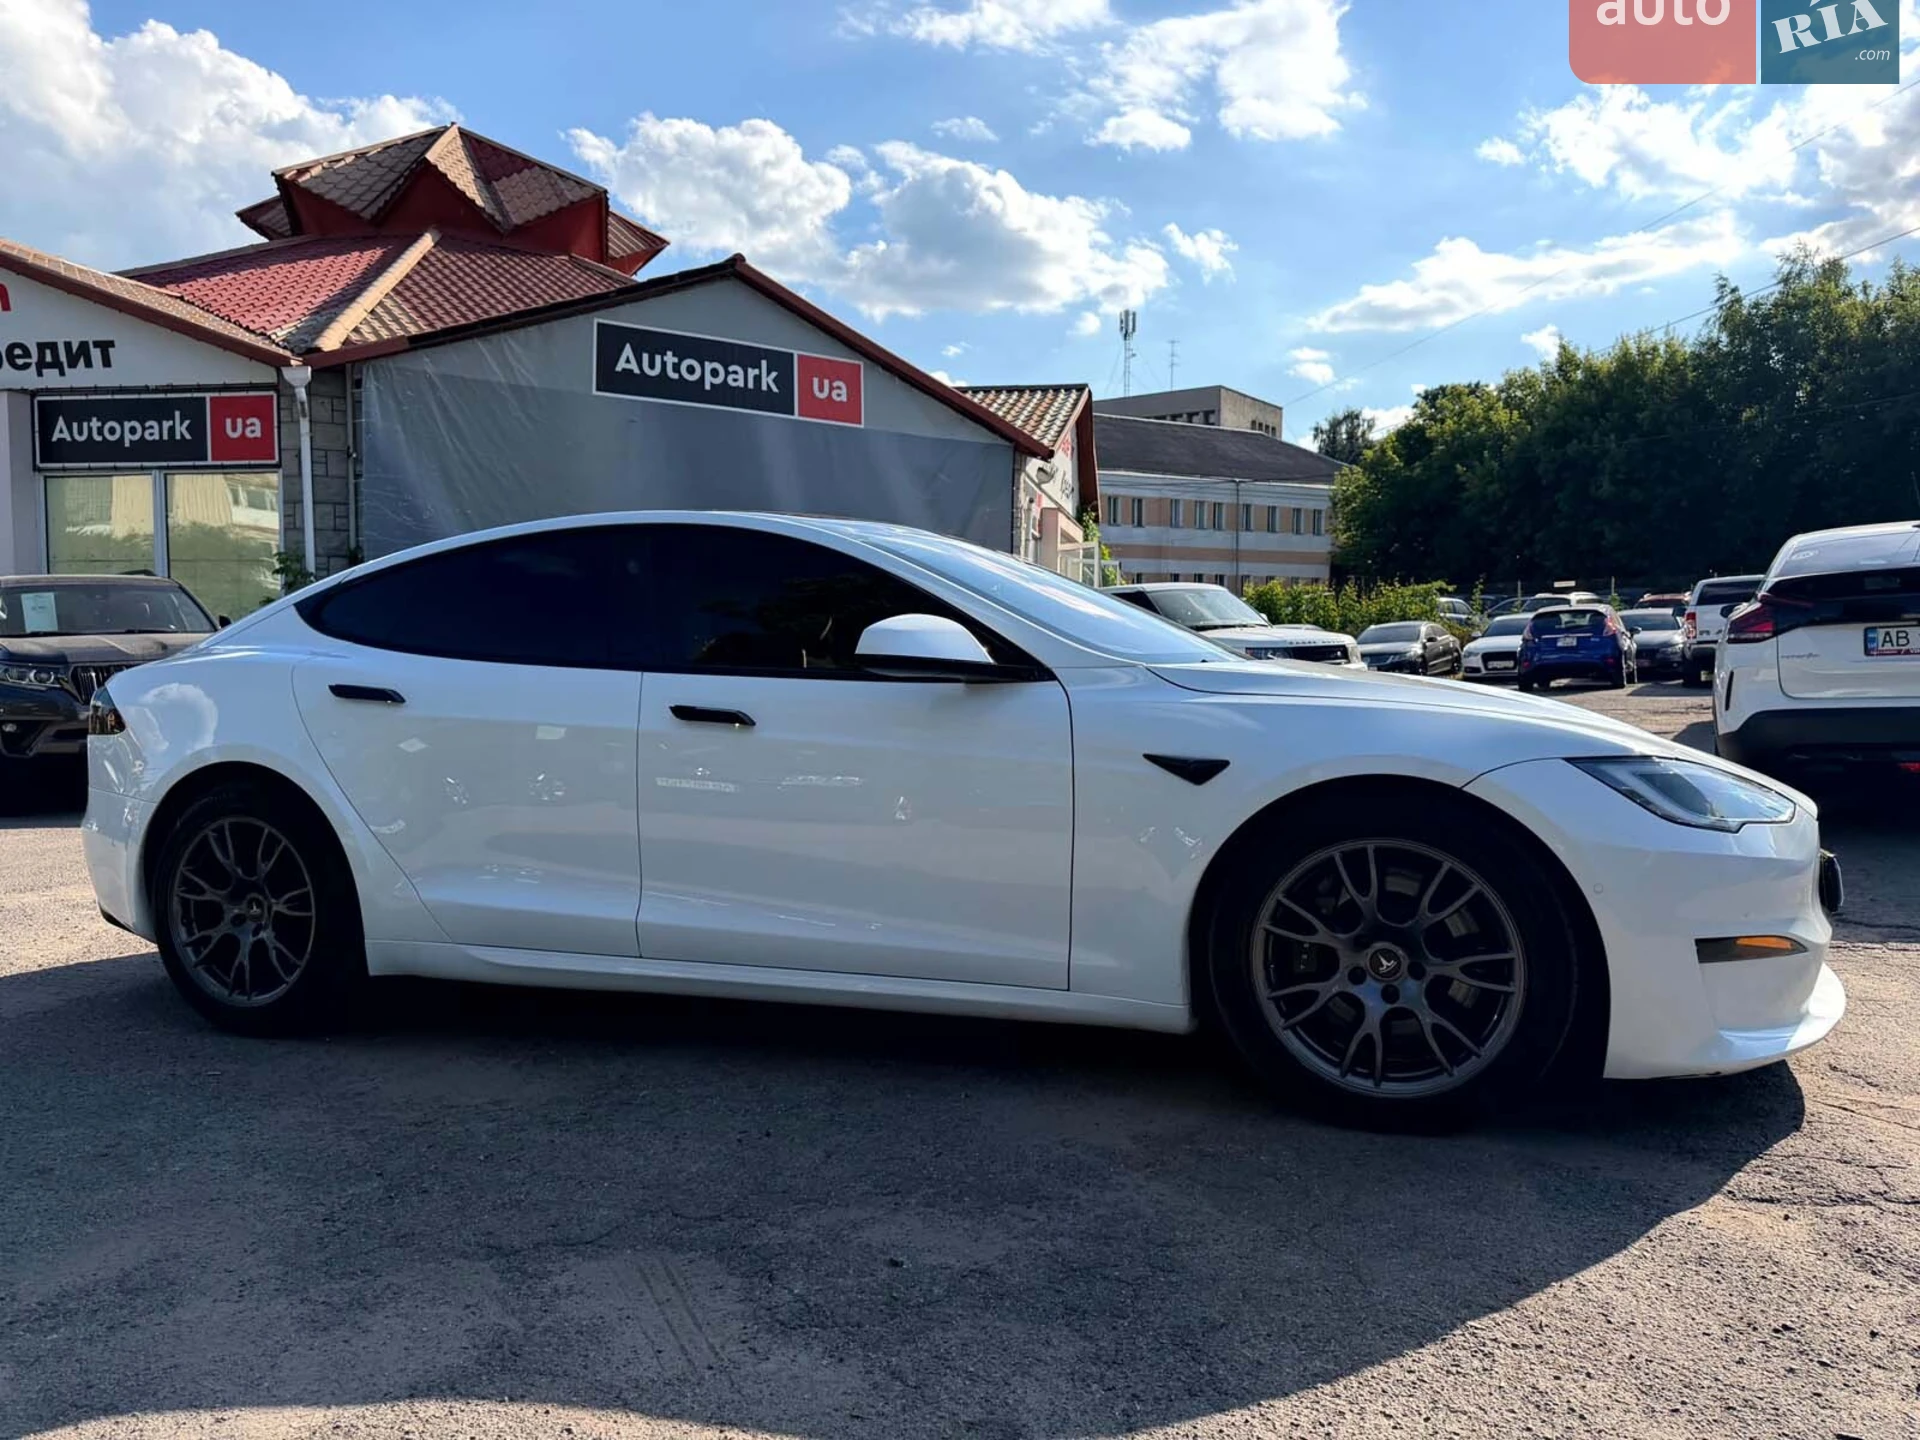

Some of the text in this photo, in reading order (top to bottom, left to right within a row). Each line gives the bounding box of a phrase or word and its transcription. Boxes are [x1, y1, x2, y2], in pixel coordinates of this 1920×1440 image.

[0, 340, 116, 378] едит
[614, 342, 848, 402] Autopark ua
[51, 410, 262, 448] Autopark ua
[1880, 630, 1911, 648] AB
